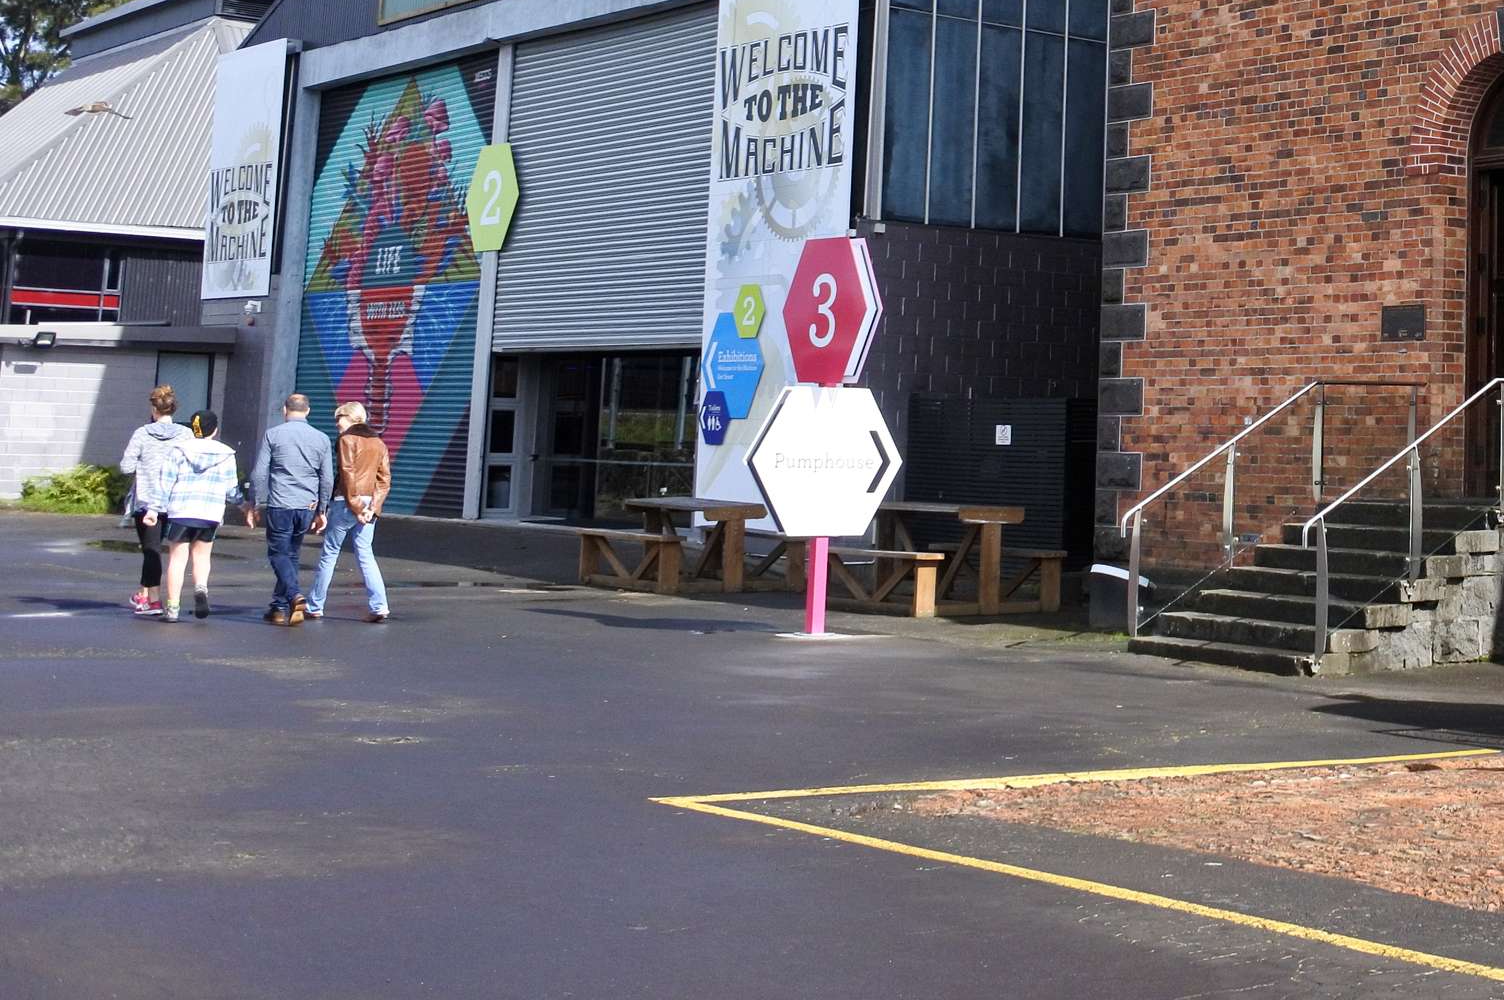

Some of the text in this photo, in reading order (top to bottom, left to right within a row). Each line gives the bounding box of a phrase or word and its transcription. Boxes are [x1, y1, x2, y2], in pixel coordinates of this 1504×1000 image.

[720, 22, 850, 111] WELCOME
[744, 83, 824, 122] TO THE
[719, 99, 846, 180] MACHINE
[210, 163, 273, 214] WELCOME
[222, 200, 260, 224] TO THE
[480, 170, 502, 226] 2
[208, 214, 269, 262] MACHINE
[375, 246, 403, 274] LIFE
[742, 296, 756, 326] 2
[809, 273, 837, 348] 3
[774, 451, 874, 473] Pumphouse
